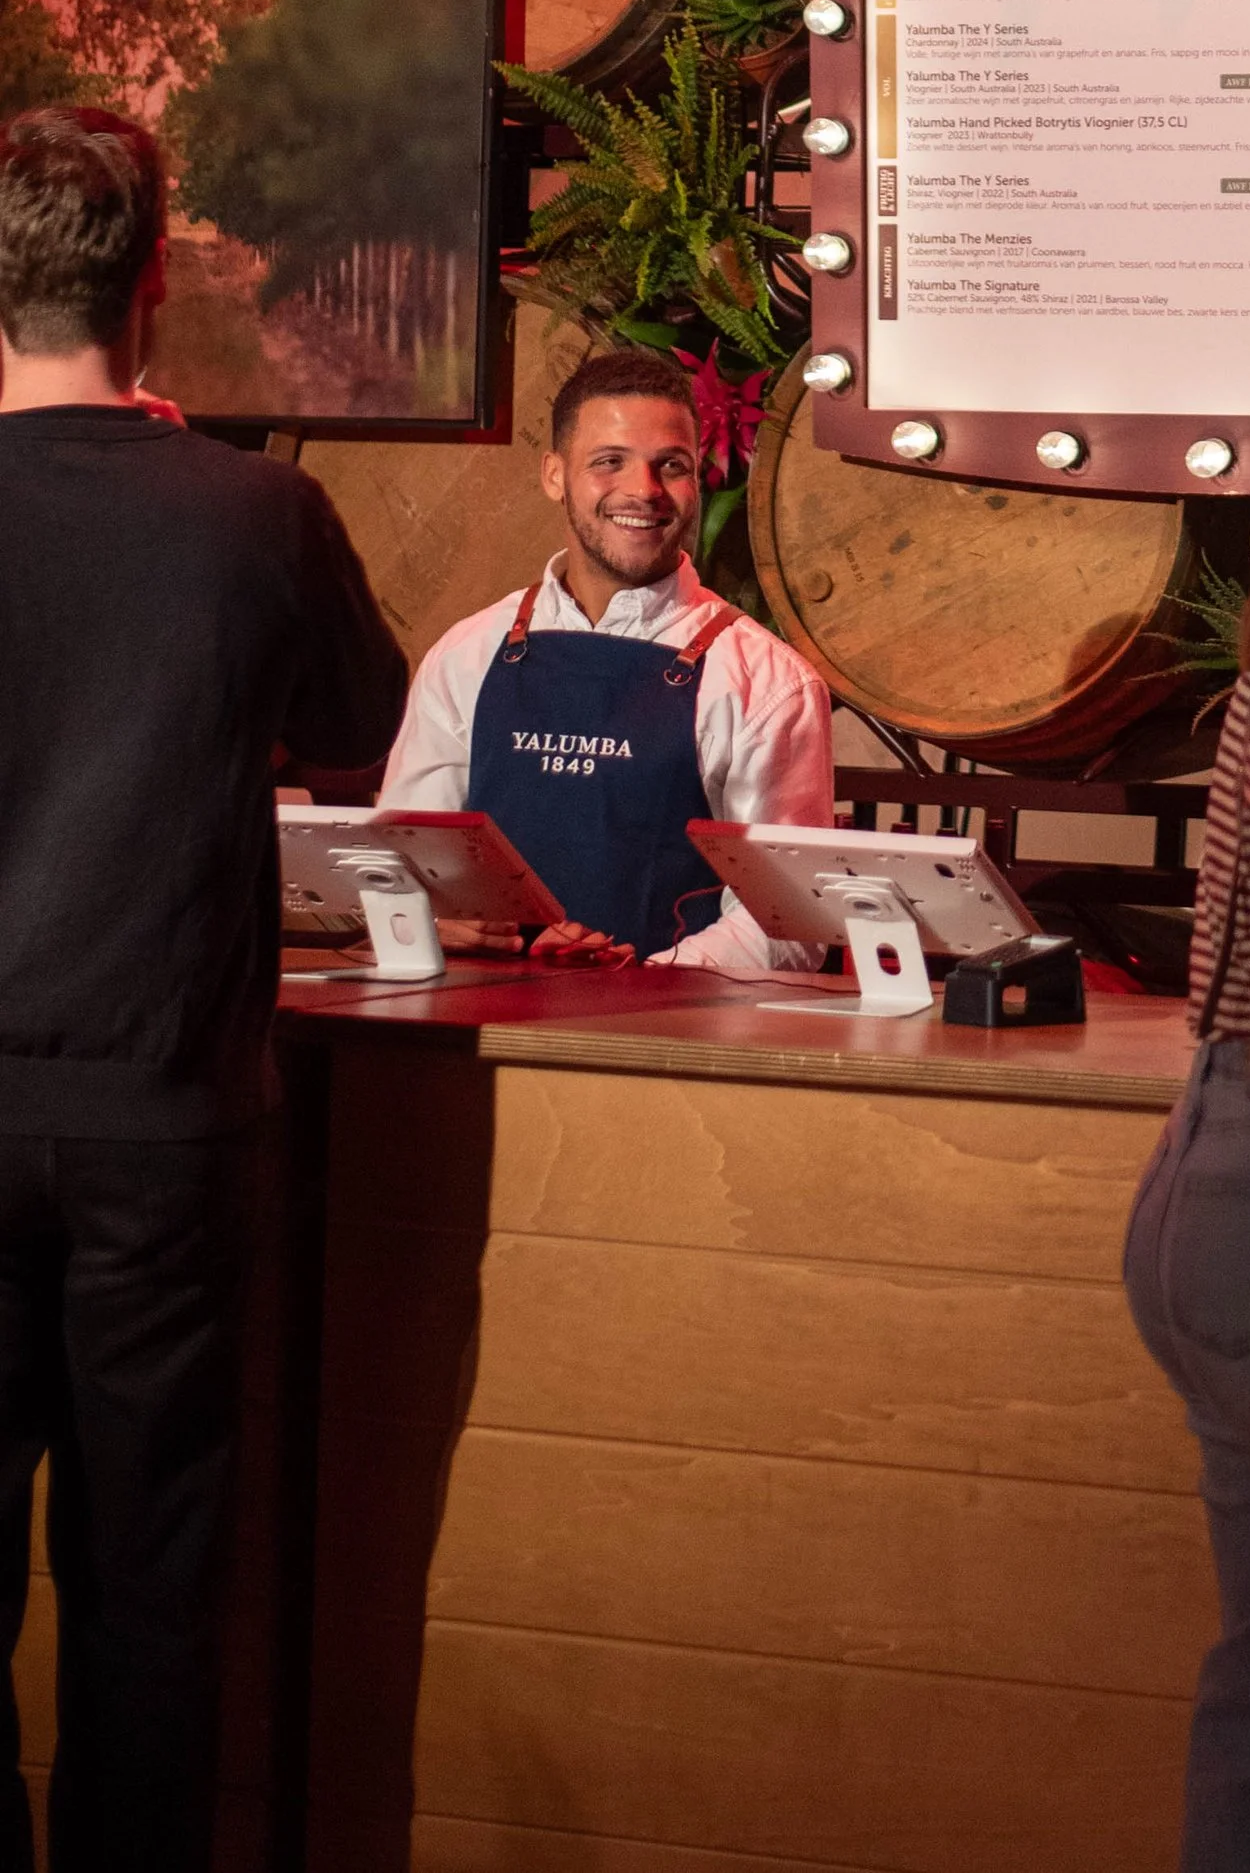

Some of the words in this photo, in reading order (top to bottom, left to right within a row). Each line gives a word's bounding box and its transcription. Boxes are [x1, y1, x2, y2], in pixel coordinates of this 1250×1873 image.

[906, 24, 955, 35] Yalumba
[960, 24, 980, 34] The
[984, 24, 990, 34] Y
[994, 24, 1028, 34] Series
[905, 38, 959, 49] Chardonnay
[966, 37, 988, 46] 2024
[996, 37, 1022, 46] South
[1024, 37, 1062, 46] Australia
[907, 71, 955, 81] Yalumba
[960, 70, 980, 81] The
[984, 70, 990, 81] Y
[994, 70, 1028, 81] Series
[882, 77, 890, 97] VOL
[1226, 78, 1246, 86] AWF
[906, 84, 942, 95] Viognier
[950, 84, 976, 92] South
[978, 84, 1016, 92] Australia
[1022, 84, 1045, 92] 2023
[1052, 83, 1079, 92] South
[1081, 83, 1119, 92] Australia
[907, 117, 955, 127] Yalumba
[959, 117, 990, 127] Hand
[993, 117, 1032, 127] Picked
[1035, 117, 1081, 130] Botrytis
[1084, 117, 1134, 130] Viognier
[1137, 117, 1164, 130] (37,5
[1167, 117, 1187, 130] CL)
[906, 130, 942, 142] Viognier
[947, 130, 969, 139] 2023
[977, 130, 1033, 142] Wrattonbully
[908, 175, 956, 186] Yalumba
[961, 175, 981, 186] The
[985, 175, 990, 186] Y
[995, 175, 1029, 186] Series
[1227, 182, 1246, 190] AWF
[937, 189, 974, 200] Viognier
[981, 189, 1004, 198] 2022
[1010, 189, 1037, 198] South
[1039, 189, 1077, 198] Australia
[908, 234, 956, 244] Yalumba
[961, 234, 981, 244] The
[984, 234, 1032, 244] Menzies
[906, 247, 947, 256] Cabernet
[949, 247, 995, 258] Sauvignon
[1002, 247, 1024, 256] 2017
[1030, 247, 1086, 256] Coonawarra
[908, 280, 956, 291] Yalumba
[961, 280, 981, 291] The
[984, 281, 1040, 293] Signature
[926, 294, 967, 303] Cabernet
[1041, 295, 1068, 303] Shiraz
[1076, 295, 1097, 303] 2021
[1105, 295, 1140, 304] Barossa
[1142, 295, 1168, 306] Valley
[512, 732, 633, 758] YALUMBA
[541, 756, 596, 775] 1849
